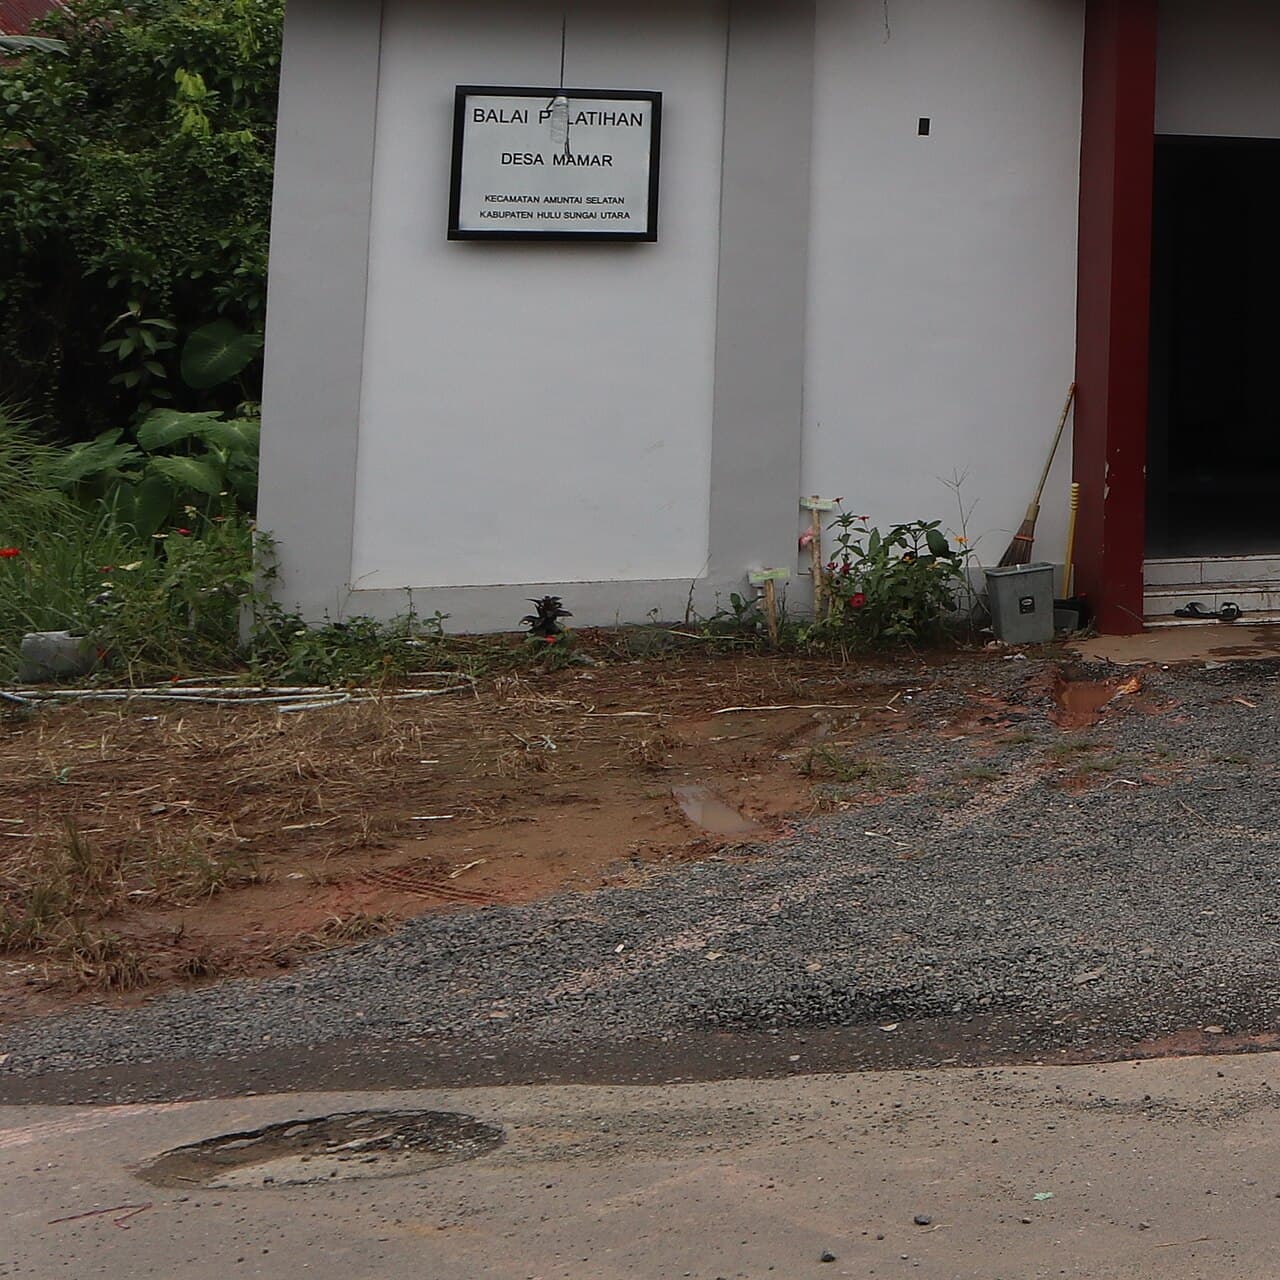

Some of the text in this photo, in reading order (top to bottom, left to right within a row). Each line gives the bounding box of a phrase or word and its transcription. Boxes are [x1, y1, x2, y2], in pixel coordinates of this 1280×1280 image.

[473, 108, 644, 127] BALAI PLATIHAN
[501, 153, 613, 167] DESA MAMAR
[485, 195, 624, 204] KECAMATAN AMUNTAI SELATAN
[479, 211, 533, 219] KABUPATEN
[563, 212, 597, 220] SUNGAI
